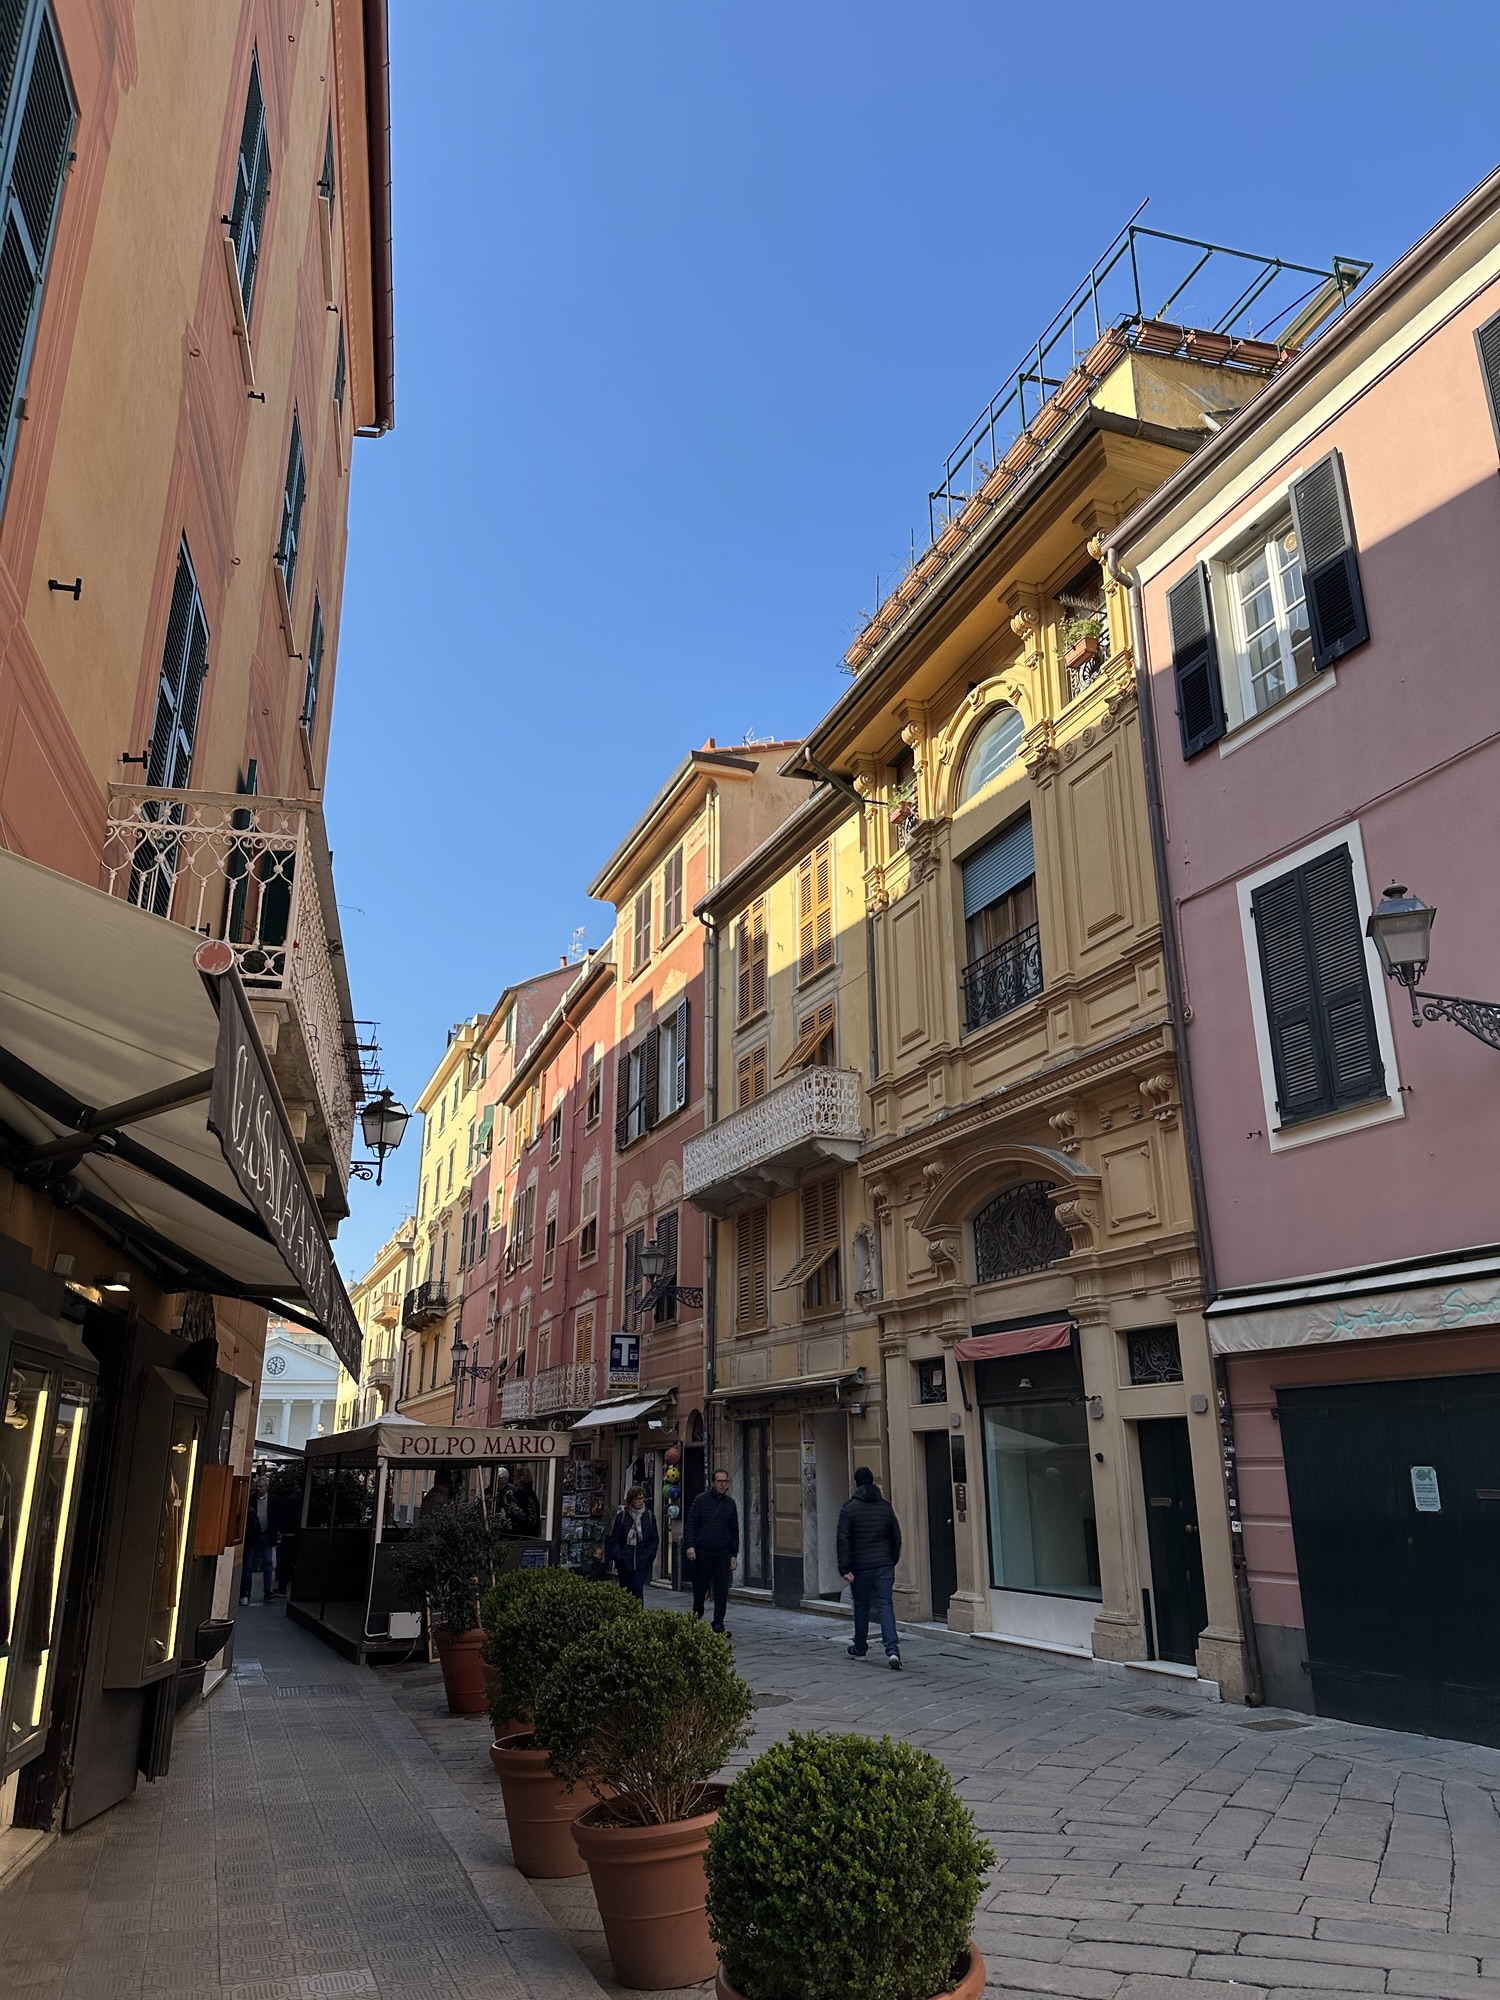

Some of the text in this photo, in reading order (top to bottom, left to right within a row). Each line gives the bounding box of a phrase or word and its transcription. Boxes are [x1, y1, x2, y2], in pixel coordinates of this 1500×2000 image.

[1329, 1303, 1424, 1340] Antica
[614, 1337, 636, 1366] T
[399, 1435, 556, 1455] POLPO MARIO
